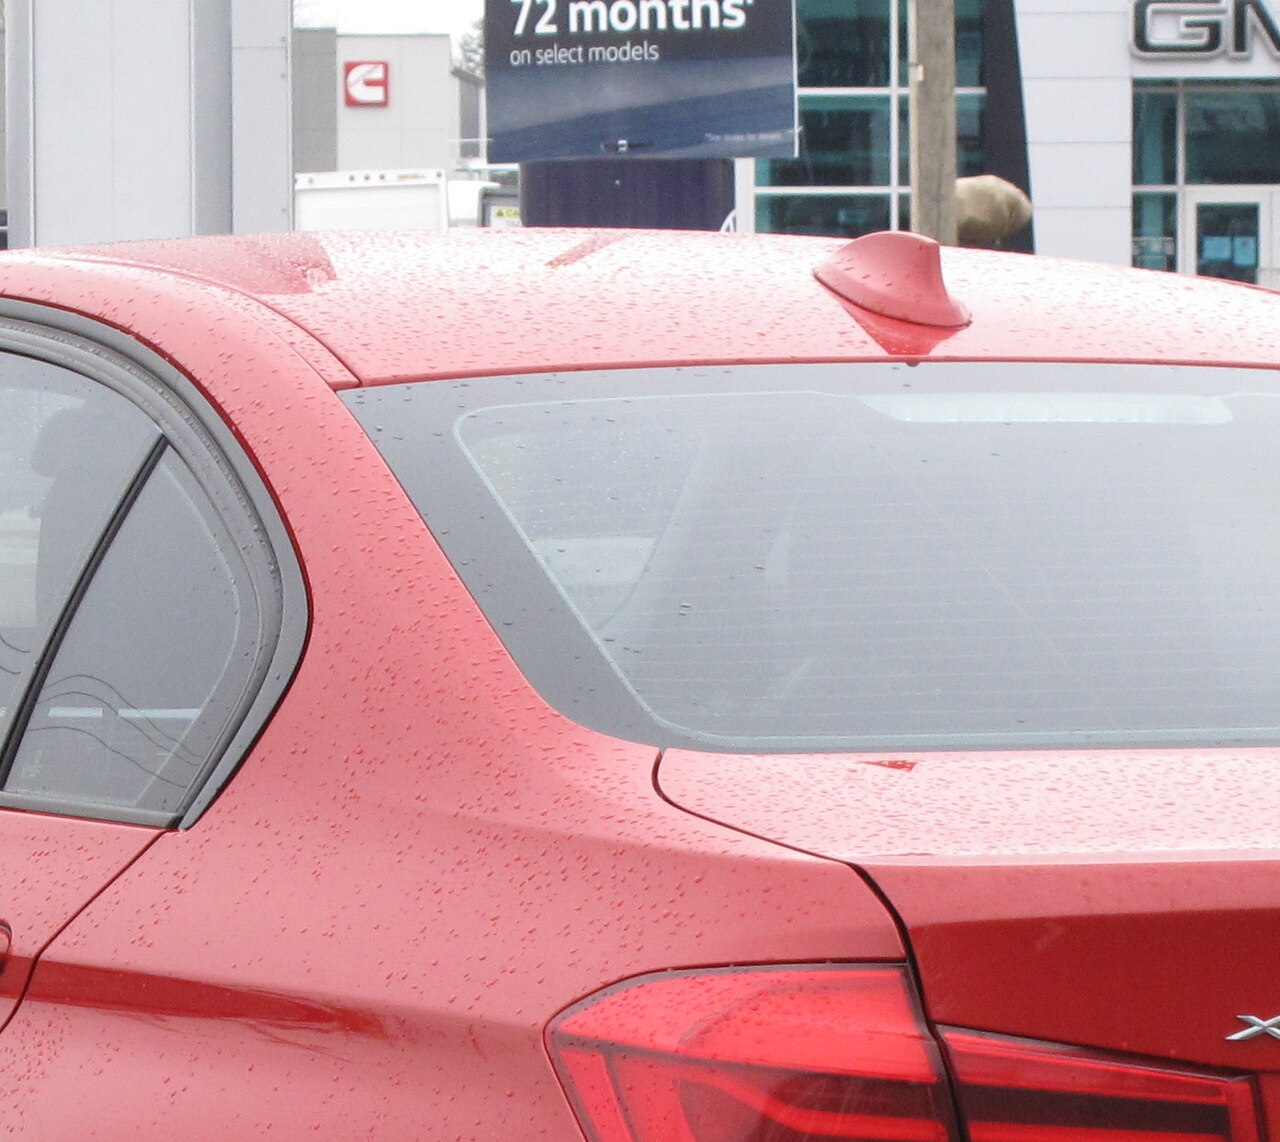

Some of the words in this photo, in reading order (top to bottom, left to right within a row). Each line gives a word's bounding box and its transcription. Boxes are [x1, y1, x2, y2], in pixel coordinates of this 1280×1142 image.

[509, 0, 558, 35] 72
[509, 49, 532, 66] on
[535, 42, 584, 64] select
[588, 40, 660, 62] models
